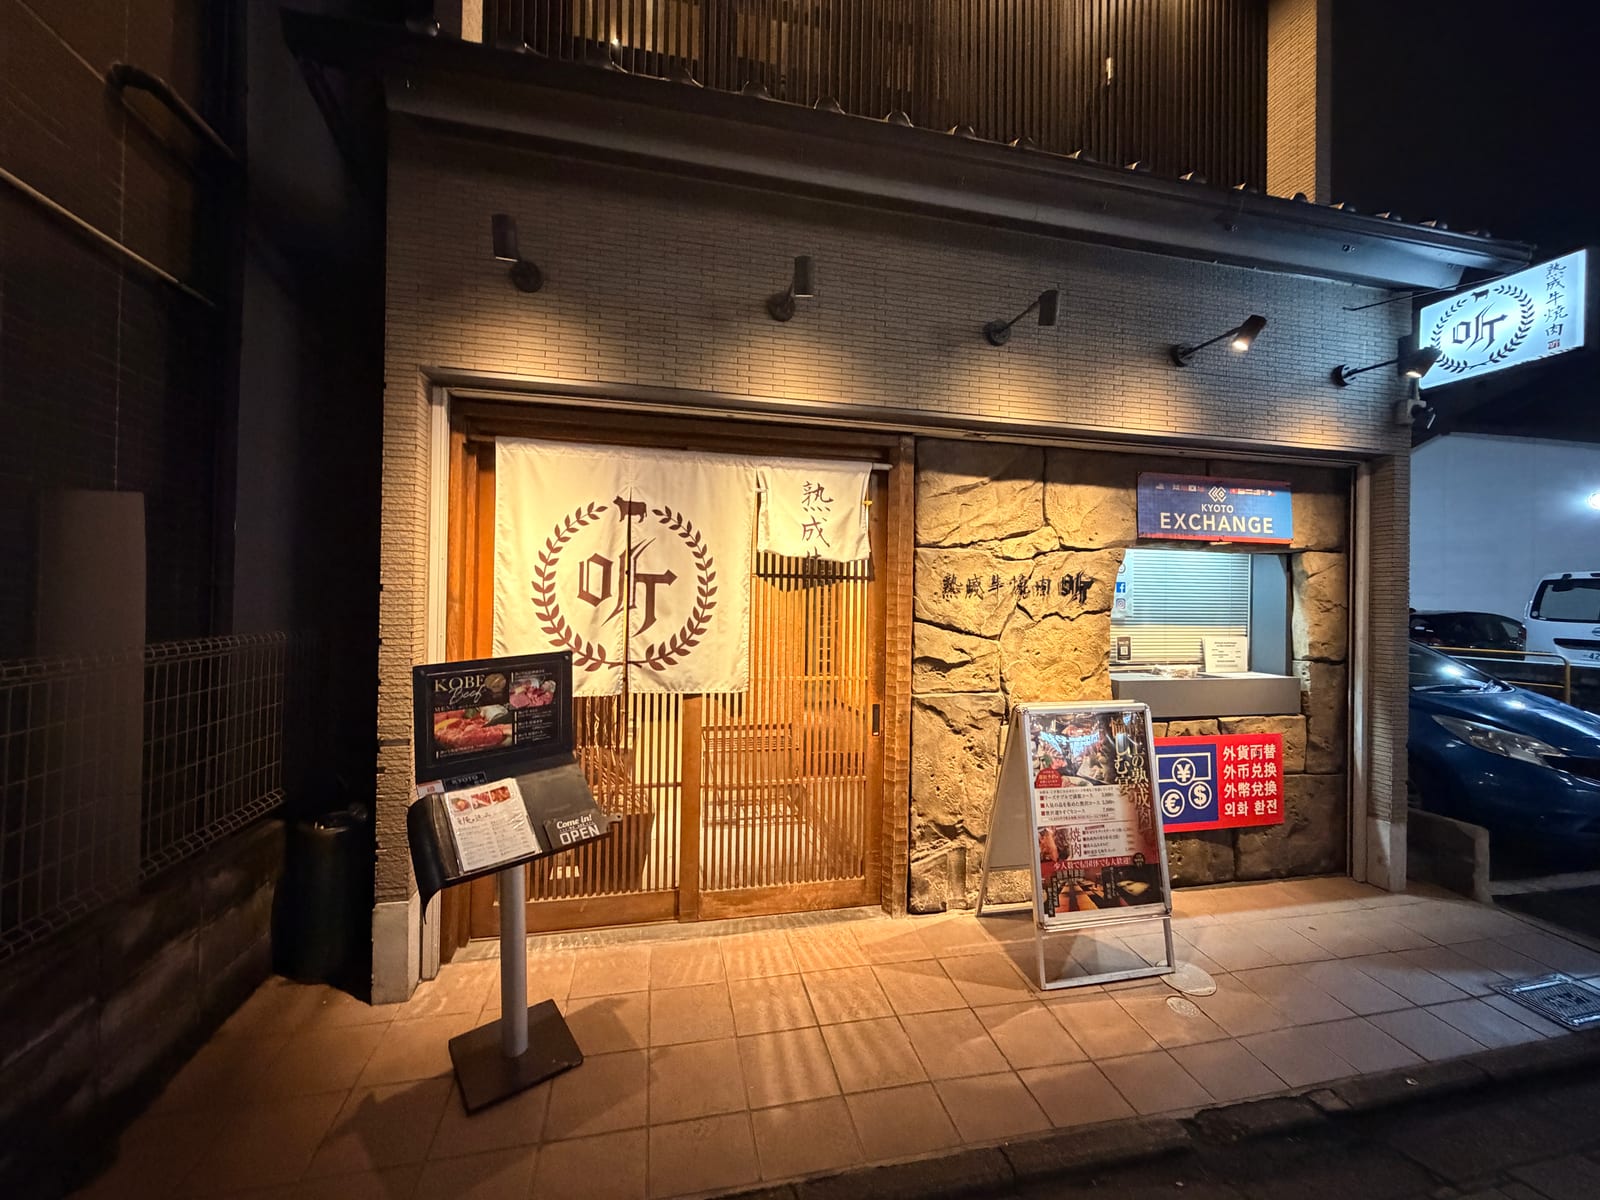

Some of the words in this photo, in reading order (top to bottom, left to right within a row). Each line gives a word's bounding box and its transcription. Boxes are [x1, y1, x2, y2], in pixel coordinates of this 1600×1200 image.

[1201, 504, 1234, 513] KYOTO
[1160, 512, 1274, 534] EXCHANGE
[434, 674, 485, 693] KOBE
[448, 684, 485, 705] Beef
[1223, 743, 1277, 761] 外貨両替
[1223, 762, 1277, 780] 外币兑换
[1224, 801, 1248, 817] 외화
[1254, 798, 1278, 815] 환전
[556, 819, 580, 829] Come
[560, 825, 600, 845] OPEN
